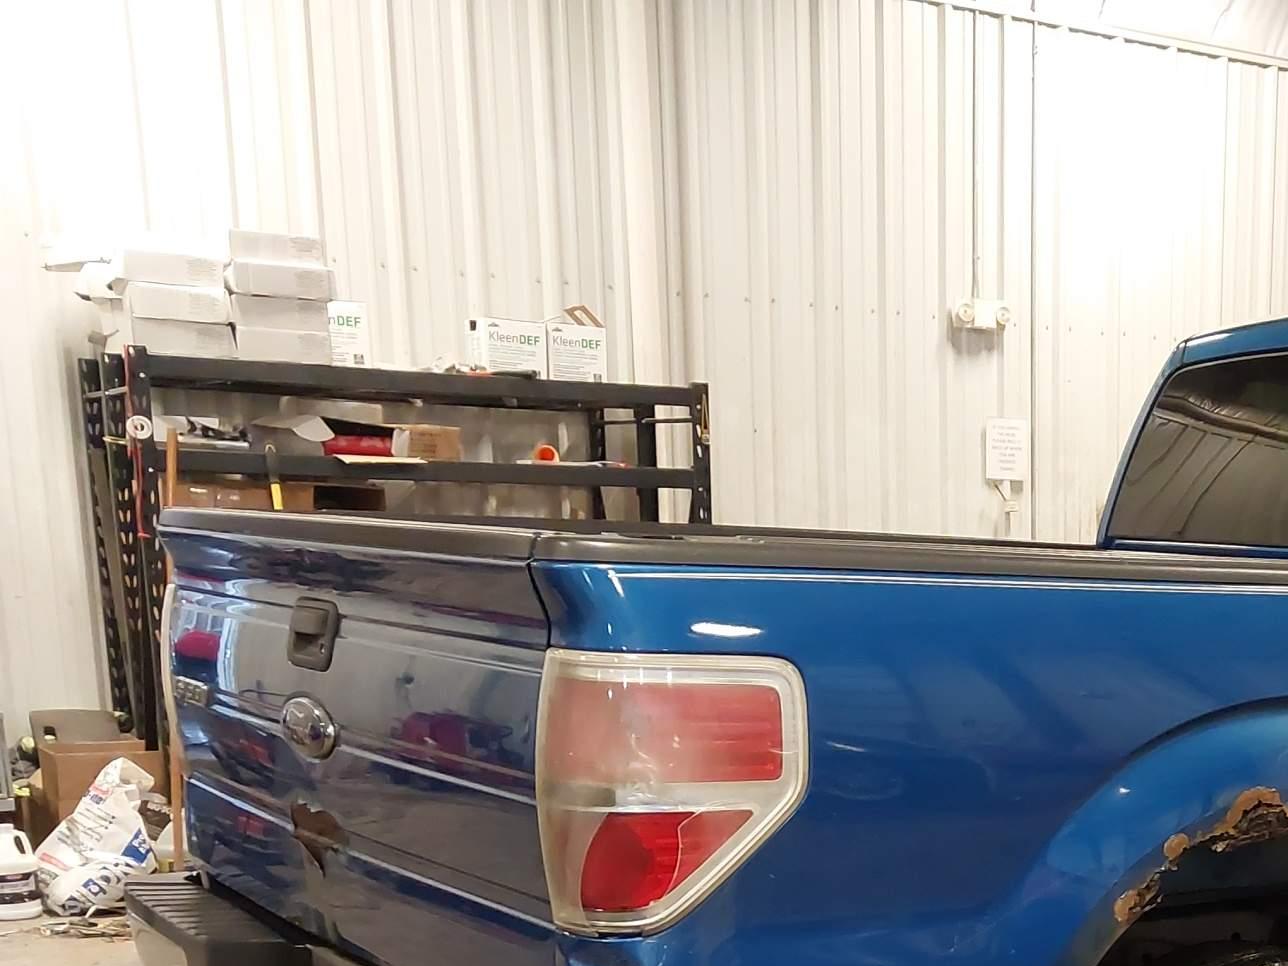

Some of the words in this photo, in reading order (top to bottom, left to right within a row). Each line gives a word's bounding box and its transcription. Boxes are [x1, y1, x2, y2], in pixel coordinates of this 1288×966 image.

[328, 315, 361, 328] nDEF
[488, 330, 540, 346] KleenDEF
[552, 335, 601, 349] KleenDEF
